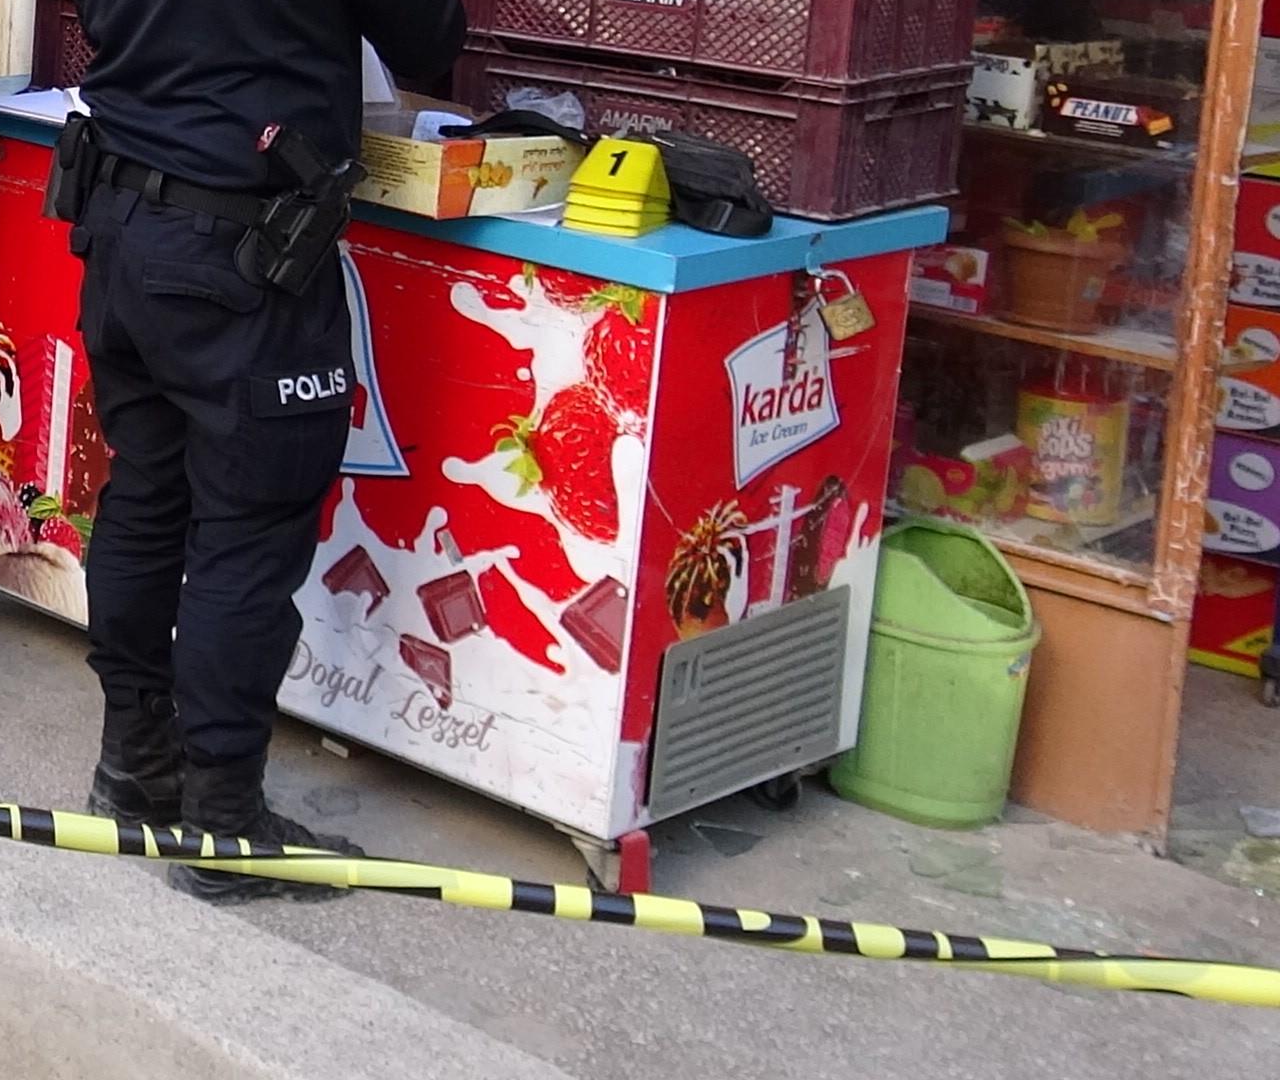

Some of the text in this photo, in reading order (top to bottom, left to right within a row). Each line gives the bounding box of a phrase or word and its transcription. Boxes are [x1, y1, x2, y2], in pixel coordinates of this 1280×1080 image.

[1070, 100, 1135, 124] PEANUT
[608, 150, 629, 176] 1
[741, 371, 825, 428] karda
[287, 639, 385, 707] Doğal
